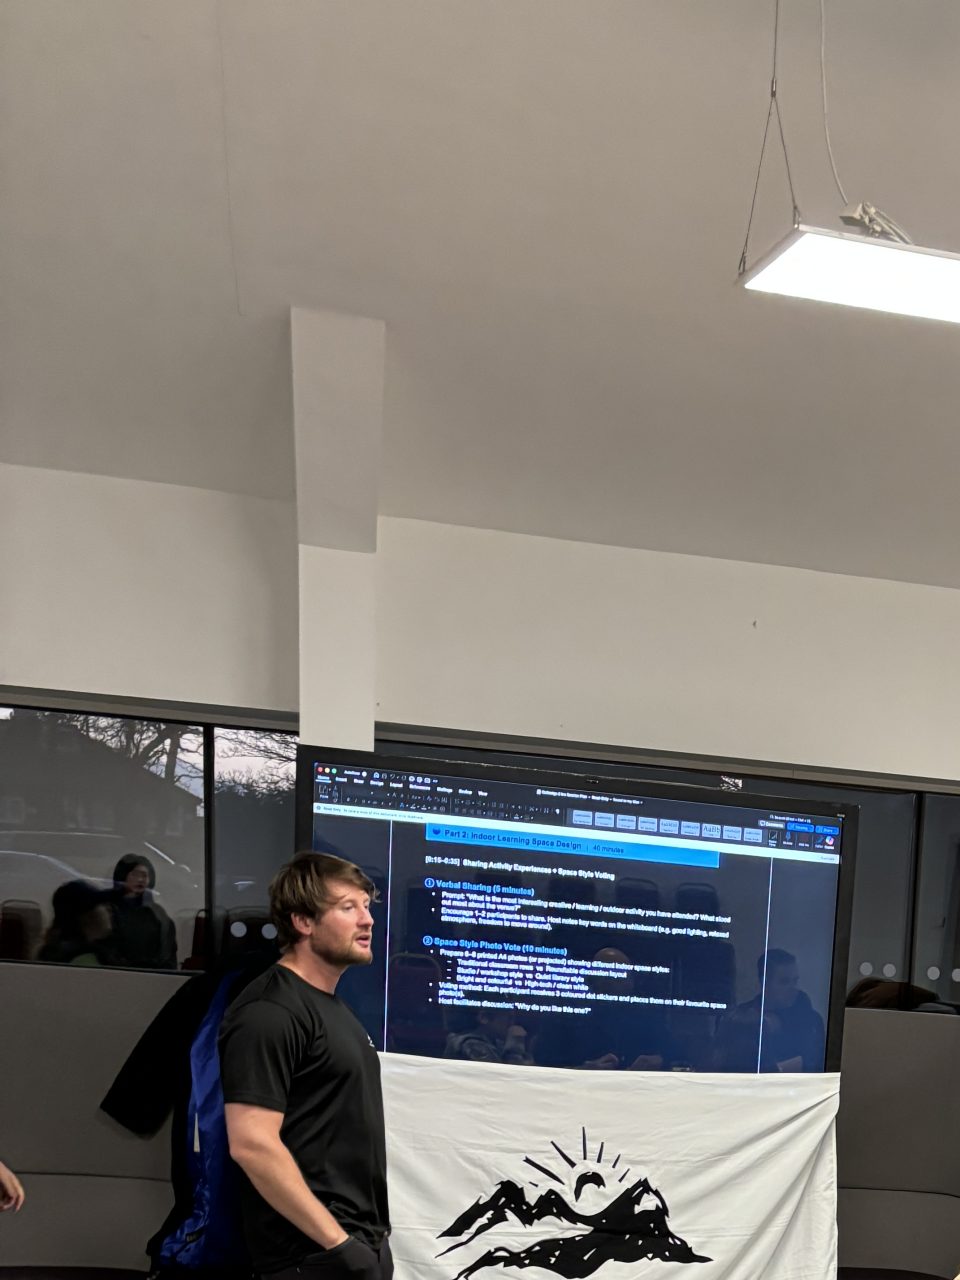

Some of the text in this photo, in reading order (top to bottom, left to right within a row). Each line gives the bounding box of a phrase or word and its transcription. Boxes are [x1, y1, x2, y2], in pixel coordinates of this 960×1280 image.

[471, 832, 495, 840] Indoor
[497, 834, 530, 845] Learning
[532, 838, 555, 848] Space
[556, 840, 582, 850] Design
[602, 844, 624, 853] minutes
[462, 859, 487, 869] Sharing
[488, 861, 512, 871] Activity
[513, 864, 551, 875] Experiences
[558, 868, 577, 877] Space
[578, 869, 594, 879] Style
[594, 871, 615, 881] Voting
[436, 879, 461, 889] Verbal
[462, 882, 492, 893] Sharing
[502, 885, 535, 897] minutes)
[434, 938, 458, 948] Space
[459, 940, 479, 950] Style
[480, 941, 502, 950] Photo
[504, 943, 521, 952] Vote
[535, 945, 568, 956] minutes)
